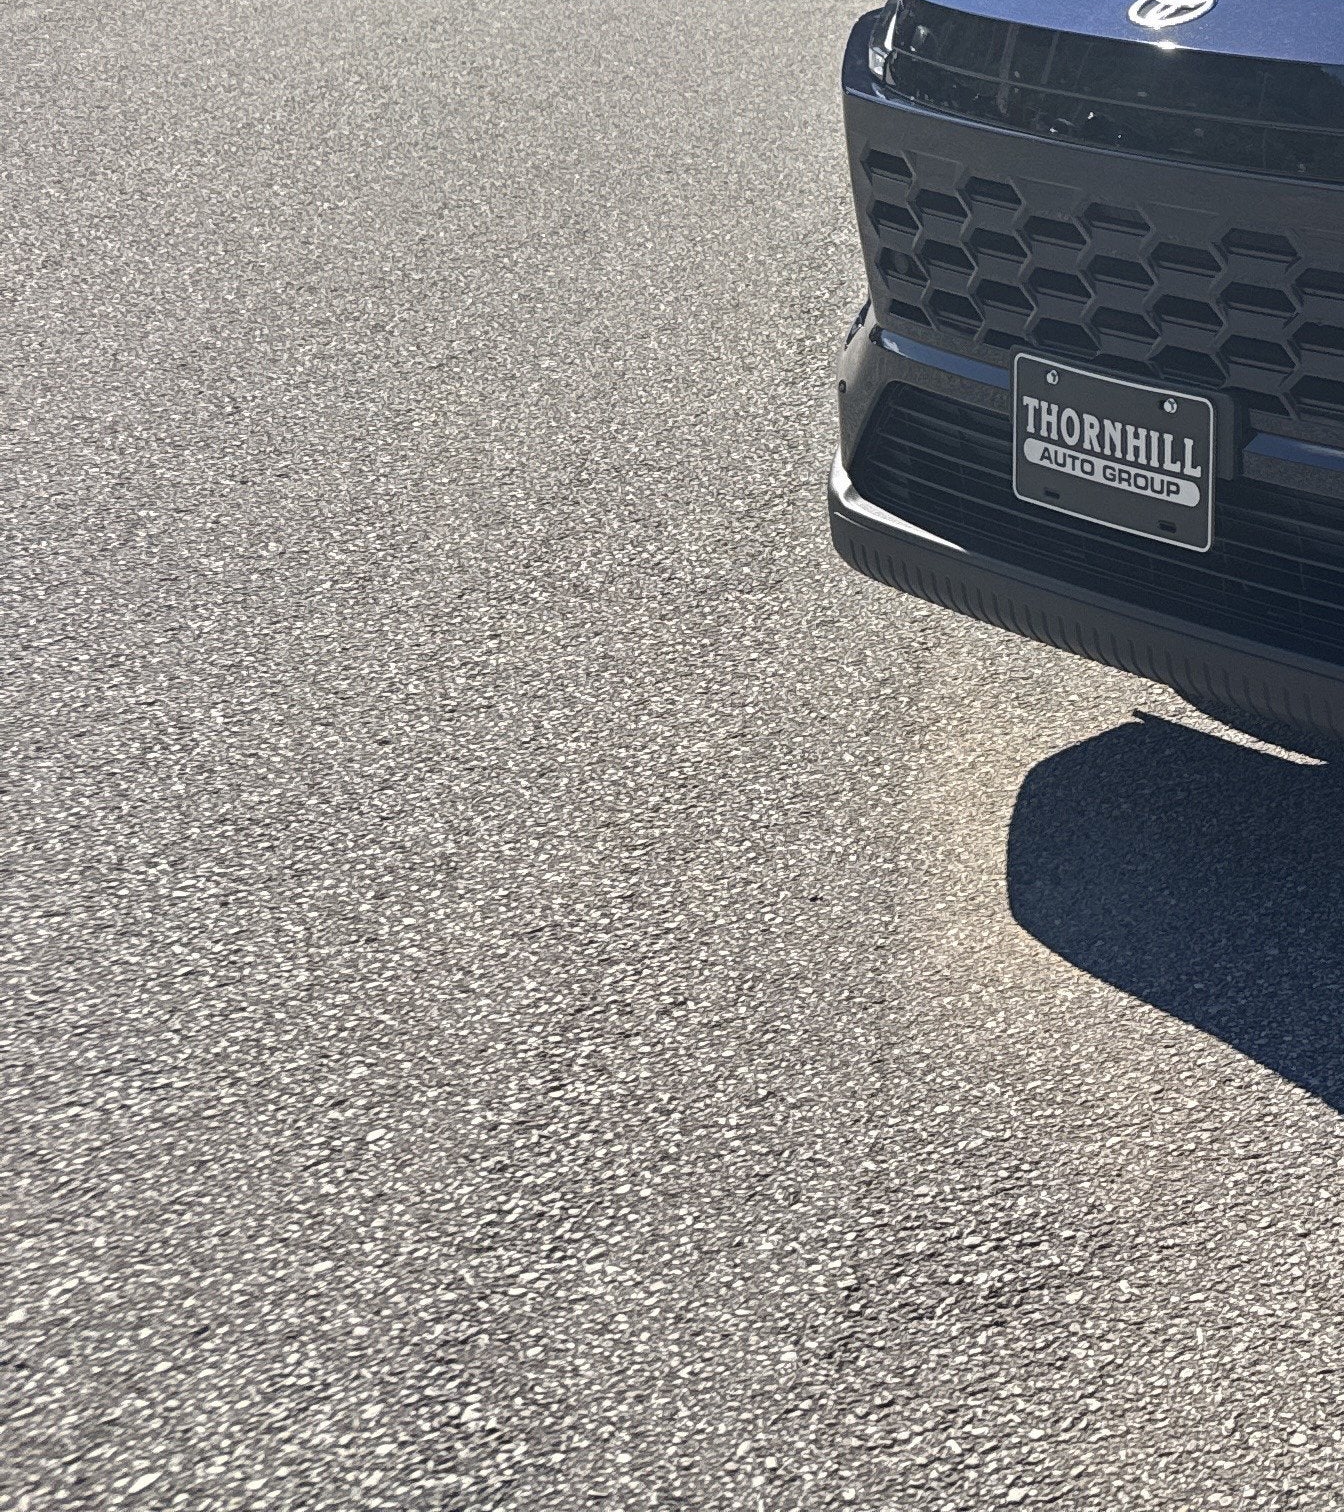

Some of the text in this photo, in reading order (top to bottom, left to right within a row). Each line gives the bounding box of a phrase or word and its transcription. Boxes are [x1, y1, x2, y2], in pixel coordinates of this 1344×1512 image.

[1022, 395, 1202, 478] THORNHILL
[1039, 446, 1181, 498] AUTO GROUP
